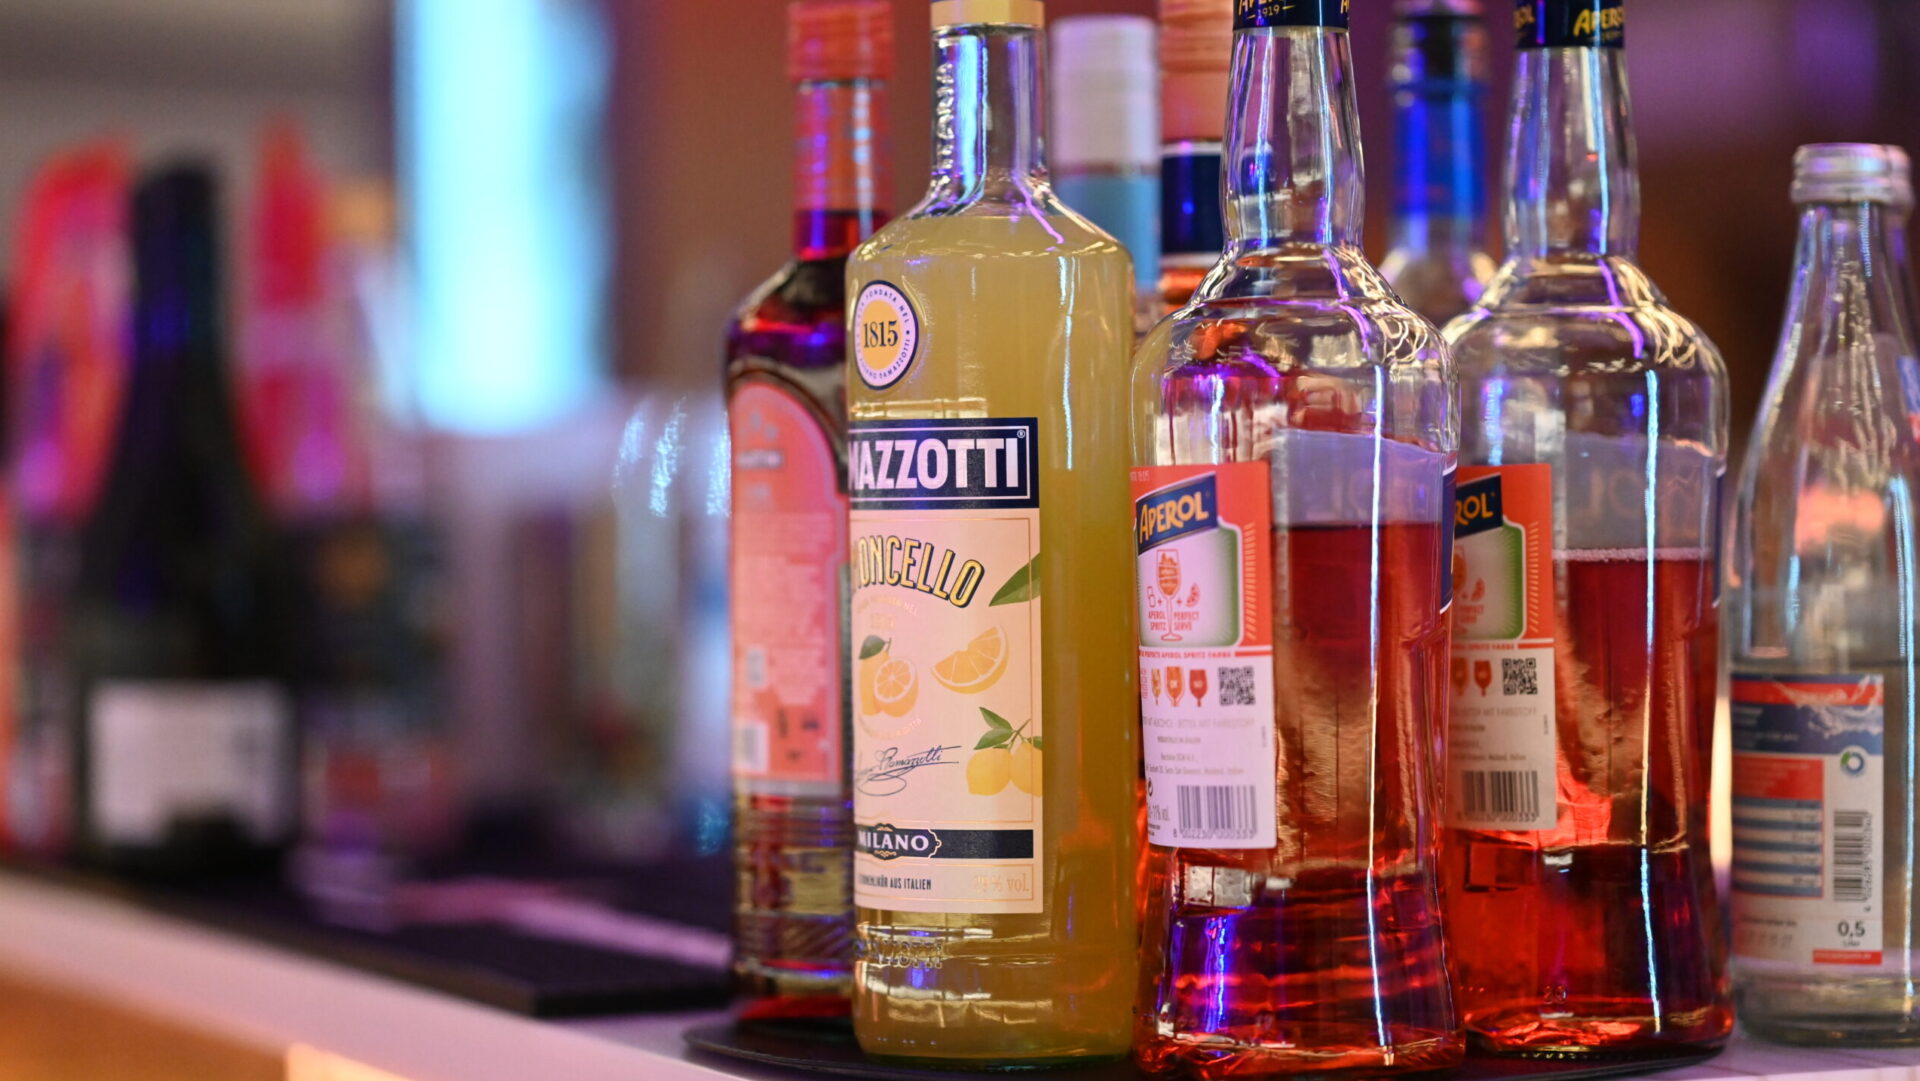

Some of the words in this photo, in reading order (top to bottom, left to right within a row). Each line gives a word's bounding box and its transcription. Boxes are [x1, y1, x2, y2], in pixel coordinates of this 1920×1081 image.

[863, 320, 899, 349] 1815
[1139, 491, 1210, 544] APEROL
[856, 535, 985, 609] ONCELLO
[890, 877, 902, 889] AUS
[903, 878, 932, 890] ITALIEN
[1838, 920, 1866, 938] 0,5
